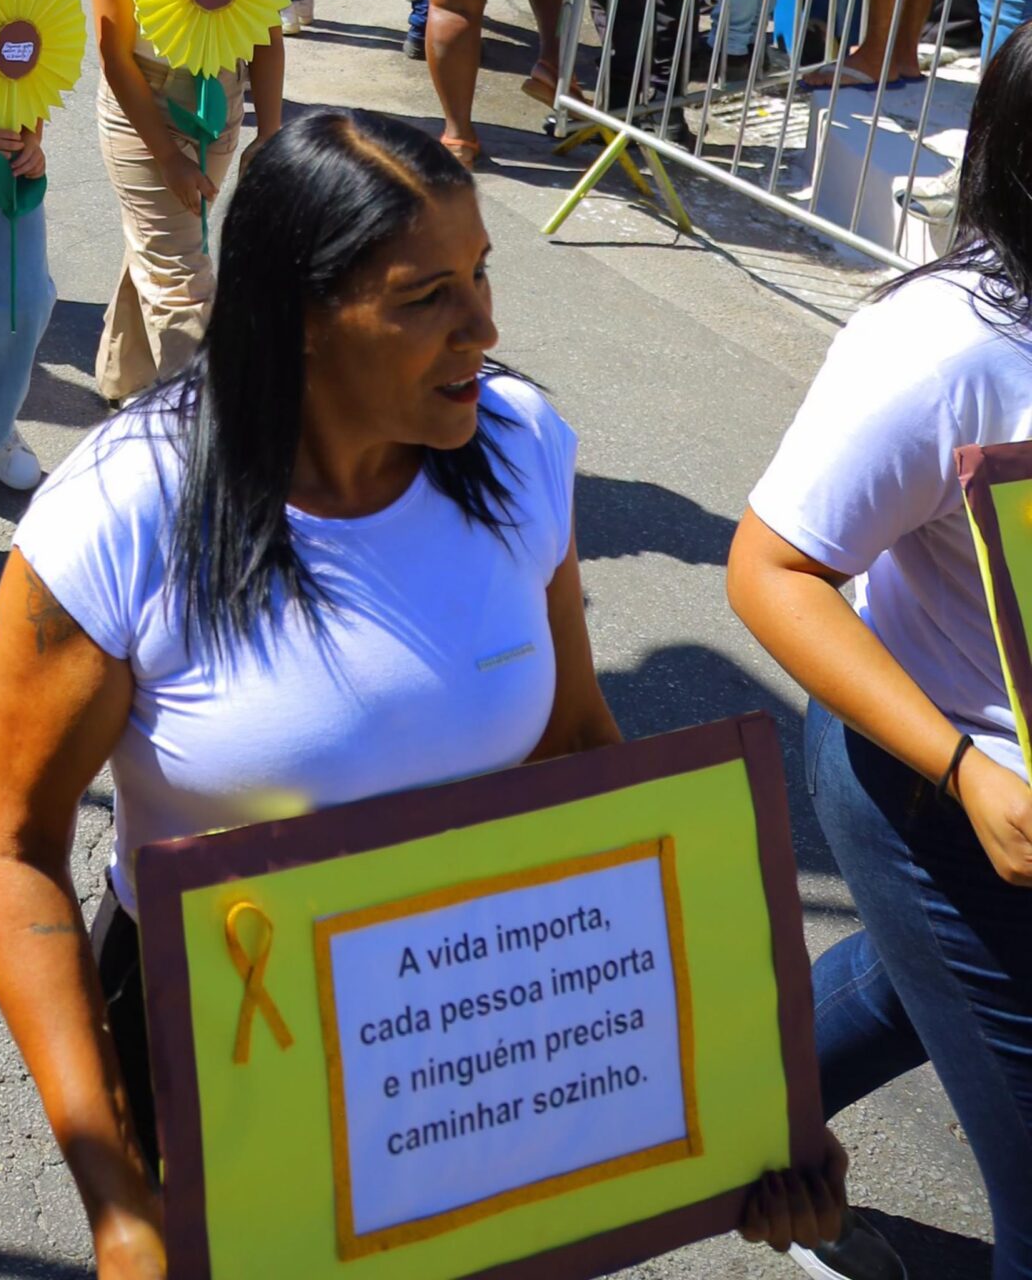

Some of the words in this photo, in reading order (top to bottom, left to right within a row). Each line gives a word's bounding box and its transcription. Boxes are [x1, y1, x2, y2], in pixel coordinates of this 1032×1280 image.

[398, 947, 421, 978] A
[427, 935, 488, 970] vida
[496, 905, 611, 954] importa,
[359, 1005, 431, 1046] cada
[440, 980, 543, 1033] pessoa
[551, 947, 655, 997] importa
[383, 1075, 400, 1099] e
[411, 1038, 536, 1093] ninguém
[544, 1007, 645, 1062] precisa
[387, 1096, 524, 1156] caminhar
[532, 1063, 648, 1116] sozinho.
